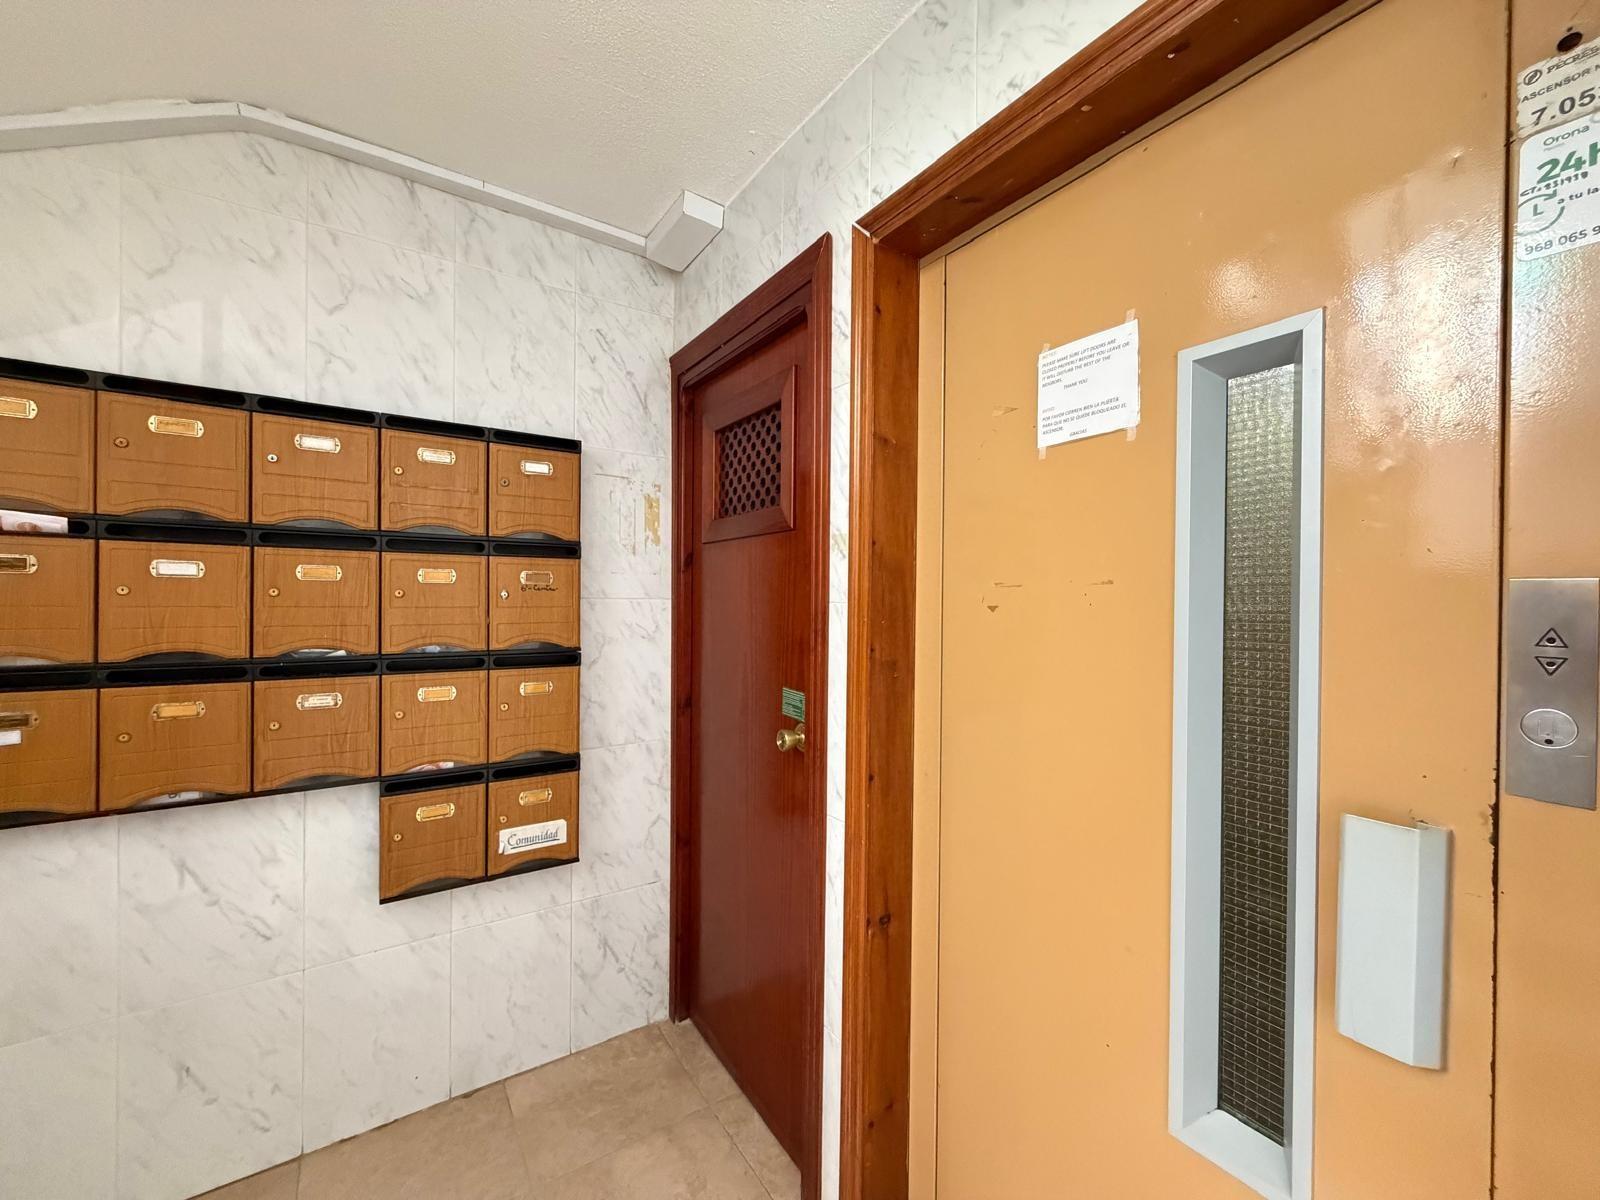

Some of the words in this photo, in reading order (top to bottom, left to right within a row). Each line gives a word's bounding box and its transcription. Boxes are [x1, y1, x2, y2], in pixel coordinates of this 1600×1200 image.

[1521, 68, 1591, 103] ASCENSOR
[1531, 87, 1600, 126] 7.05
[1543, 125, 1589, 146] Orona
[1569, 192, 1583, 201] tu
[1587, 187, 1600, 196] la
[1525, 239, 1553, 256] 968
[1558, 229, 1588, 246] 065
[1042, 360, 1056, 368] PLEASE
[1090, 342, 1106, 352] DOORS
[1042, 366, 1057, 375] CLOSED
[1058, 359, 1078, 370] PROPERLY
[1079, 354, 1095, 363] BEFORE
[1107, 344, 1121, 353] LEAVE
[1064, 382, 1077, 390] THANK
[1091, 404, 1120, 416] BLOQUEADO
[1100, 397, 1119, 406] PUERTA
[507, 827, 560, 847] Comunidad
